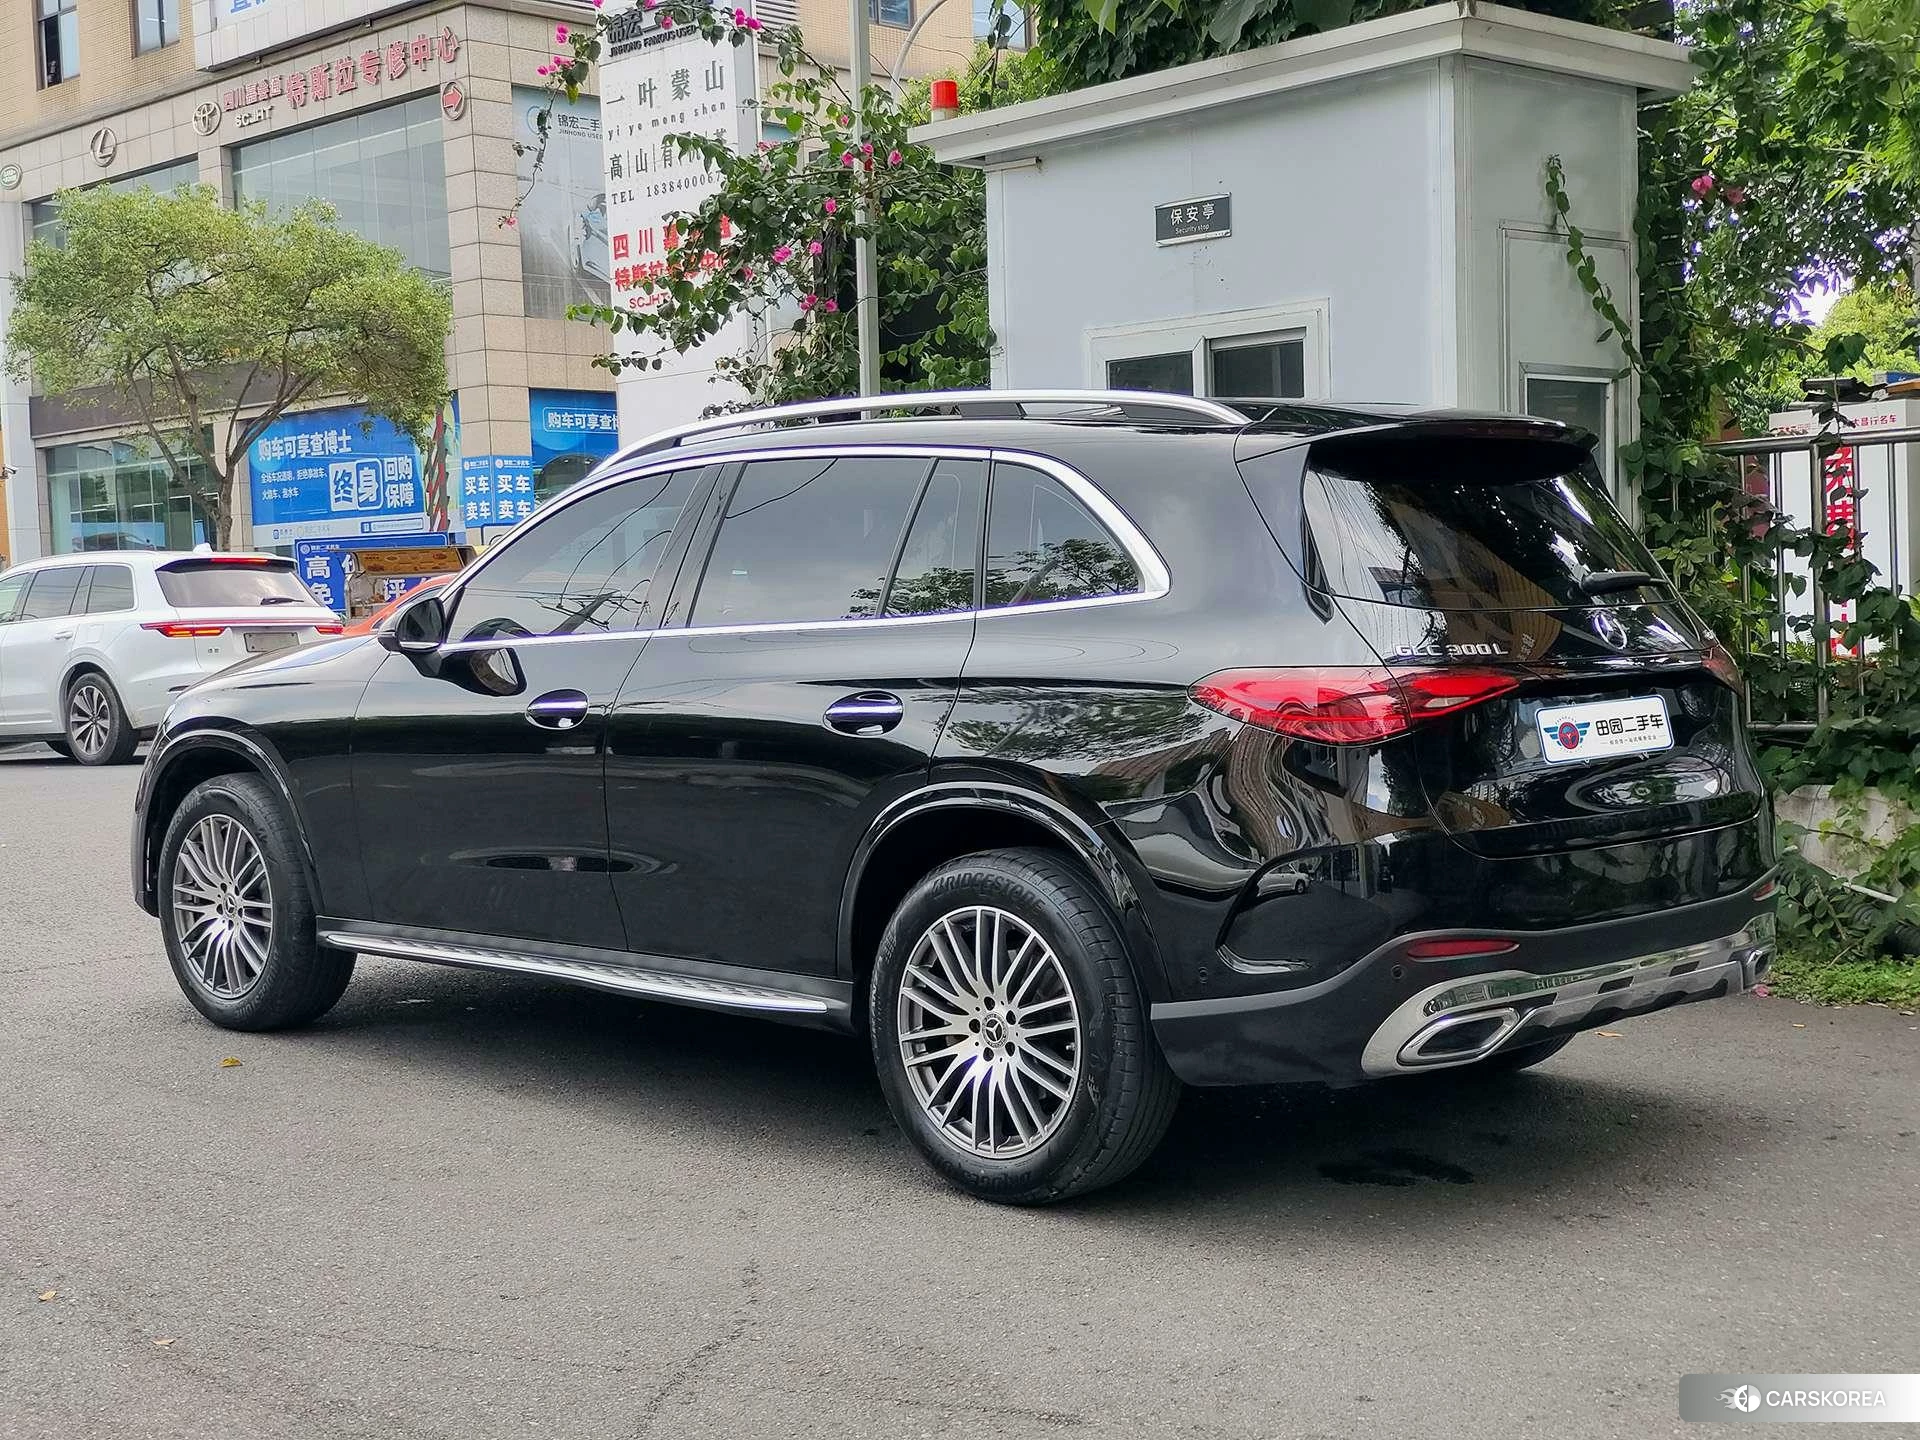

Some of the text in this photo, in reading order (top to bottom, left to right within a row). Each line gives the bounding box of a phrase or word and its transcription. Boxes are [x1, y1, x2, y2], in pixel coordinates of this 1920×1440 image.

[609, 39, 642, 57] JINHONG
[643, 30, 676, 49] FAMOUS
[286, 26, 459, 110] 特斯拉专修中心
[606, 60, 724, 109] 一叶蒙山
[694, 101, 726, 117] shan
[559, 129, 586, 137] JINHONG
[611, 190, 635, 205] TEL
[1170, 203, 1215, 226] 保安亭
[1175, 223, 1210, 235] Security stop
[257, 428, 352, 462] 购车可享查博士
[383, 456, 413, 482] 回购
[333, 467, 379, 504] 终身
[385, 481, 415, 508] 保障
[465, 475, 490, 496] 买车
[497, 474, 532, 494] 买车
[466, 501, 491, 521] 卖车
[499, 500, 532, 519] 卖车
[1395, 644, 1443, 656] GLC
[1595, 714, 1664, 736] 田园二手车
